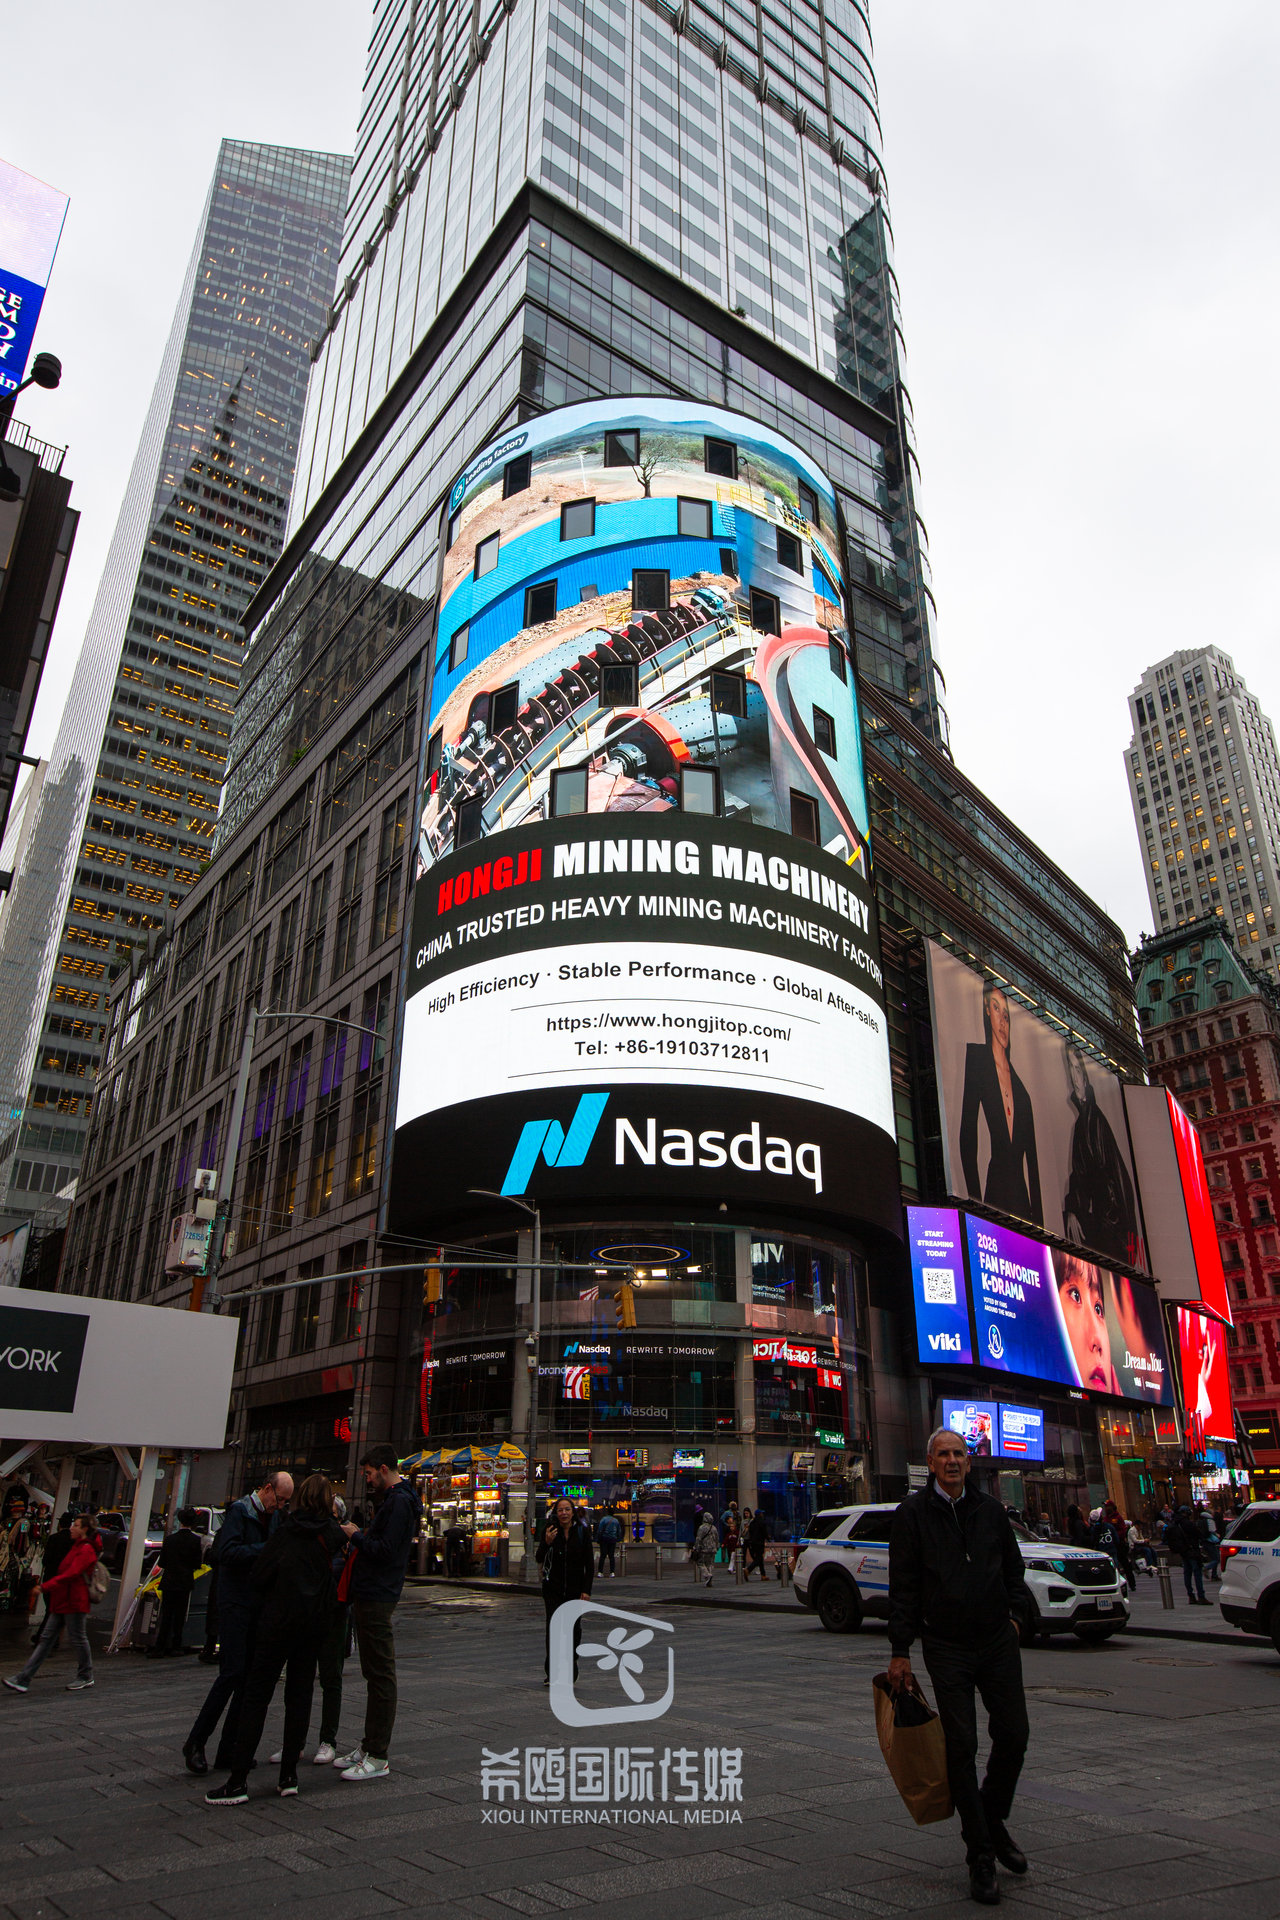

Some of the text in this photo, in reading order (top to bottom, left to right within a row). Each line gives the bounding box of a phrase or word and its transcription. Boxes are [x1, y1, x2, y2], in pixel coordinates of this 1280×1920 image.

[466, 436, 525, 485] Leading factory
[437, 839, 870, 935] HONGJI MINING MACHINERY
[415, 931, 453, 970] CHINA
[457, 903, 544, 943] TRUSTED
[551, 895, 632, 923] HEAVY
[638, 895, 723, 920] MINING
[729, 903, 839, 954] MACHINERY
[427, 960, 879, 1034] High Efficiency Stable Performance Global After-sales
[546, 1012, 792, 1042] https://www.hongjitop.com/
[575, 1039, 769, 1064] Tel: +86-19103712811
[615, 1118, 823, 1195] Nasdaq
[917, 1240, 954, 1248] STREAMING
[924, 1230, 944, 1238] START
[977, 1232, 998, 1254] 2026
[979, 1252, 1040, 1289] FAN FAVORITE
[981, 1272, 1025, 1302] K-DRAMA
[446, 1355, 467, 1365] REWRITE
[470, 1351, 506, 1362] TOMORROW
[578, 1344, 715, 1355] Nasdaq REWRITE TOMORROW
[1123, 1351, 1146, 1371] Dream
[1150, 1353, 1164, 1373] You
[623, 1405, 669, 1419] Nasdaq
